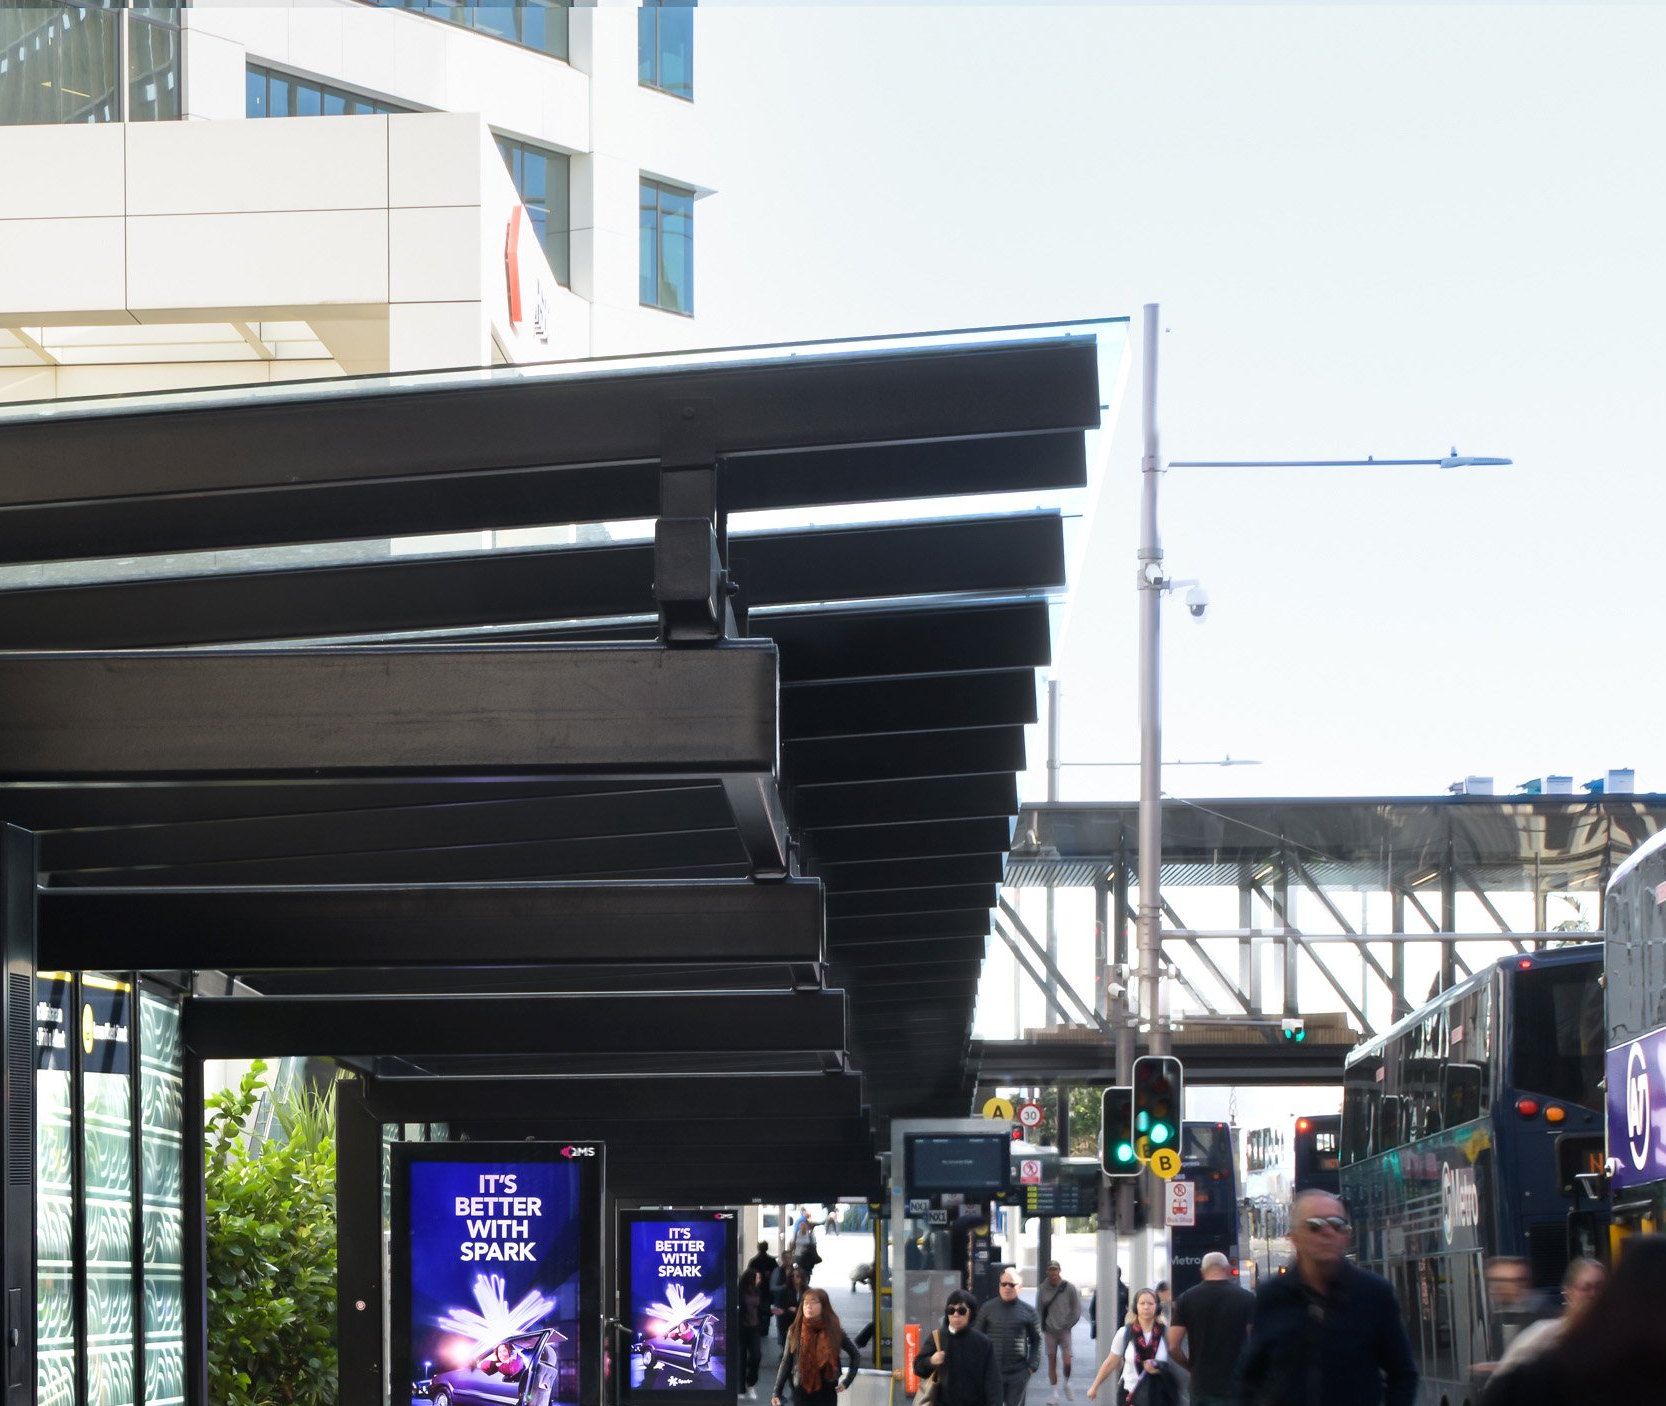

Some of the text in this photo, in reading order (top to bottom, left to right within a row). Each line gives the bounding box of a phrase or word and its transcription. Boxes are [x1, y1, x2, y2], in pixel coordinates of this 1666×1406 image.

[992, 1104, 1004, 1119] A
[1023, 1111, 1037, 1121] 30
[1159, 1155, 1172, 1171] B
[479, 1174, 518, 1194] IT'S
[455, 1197, 542, 1216] BETTER
[466, 1219, 529, 1239] WITH
[669, 1227, 691, 1239] IT'S
[460, 1242, 537, 1262] SPARK
[655, 1240, 705, 1252] BETTER
[662, 1253, 698, 1264] WITH
[658, 1265, 702, 1277] SPARK
